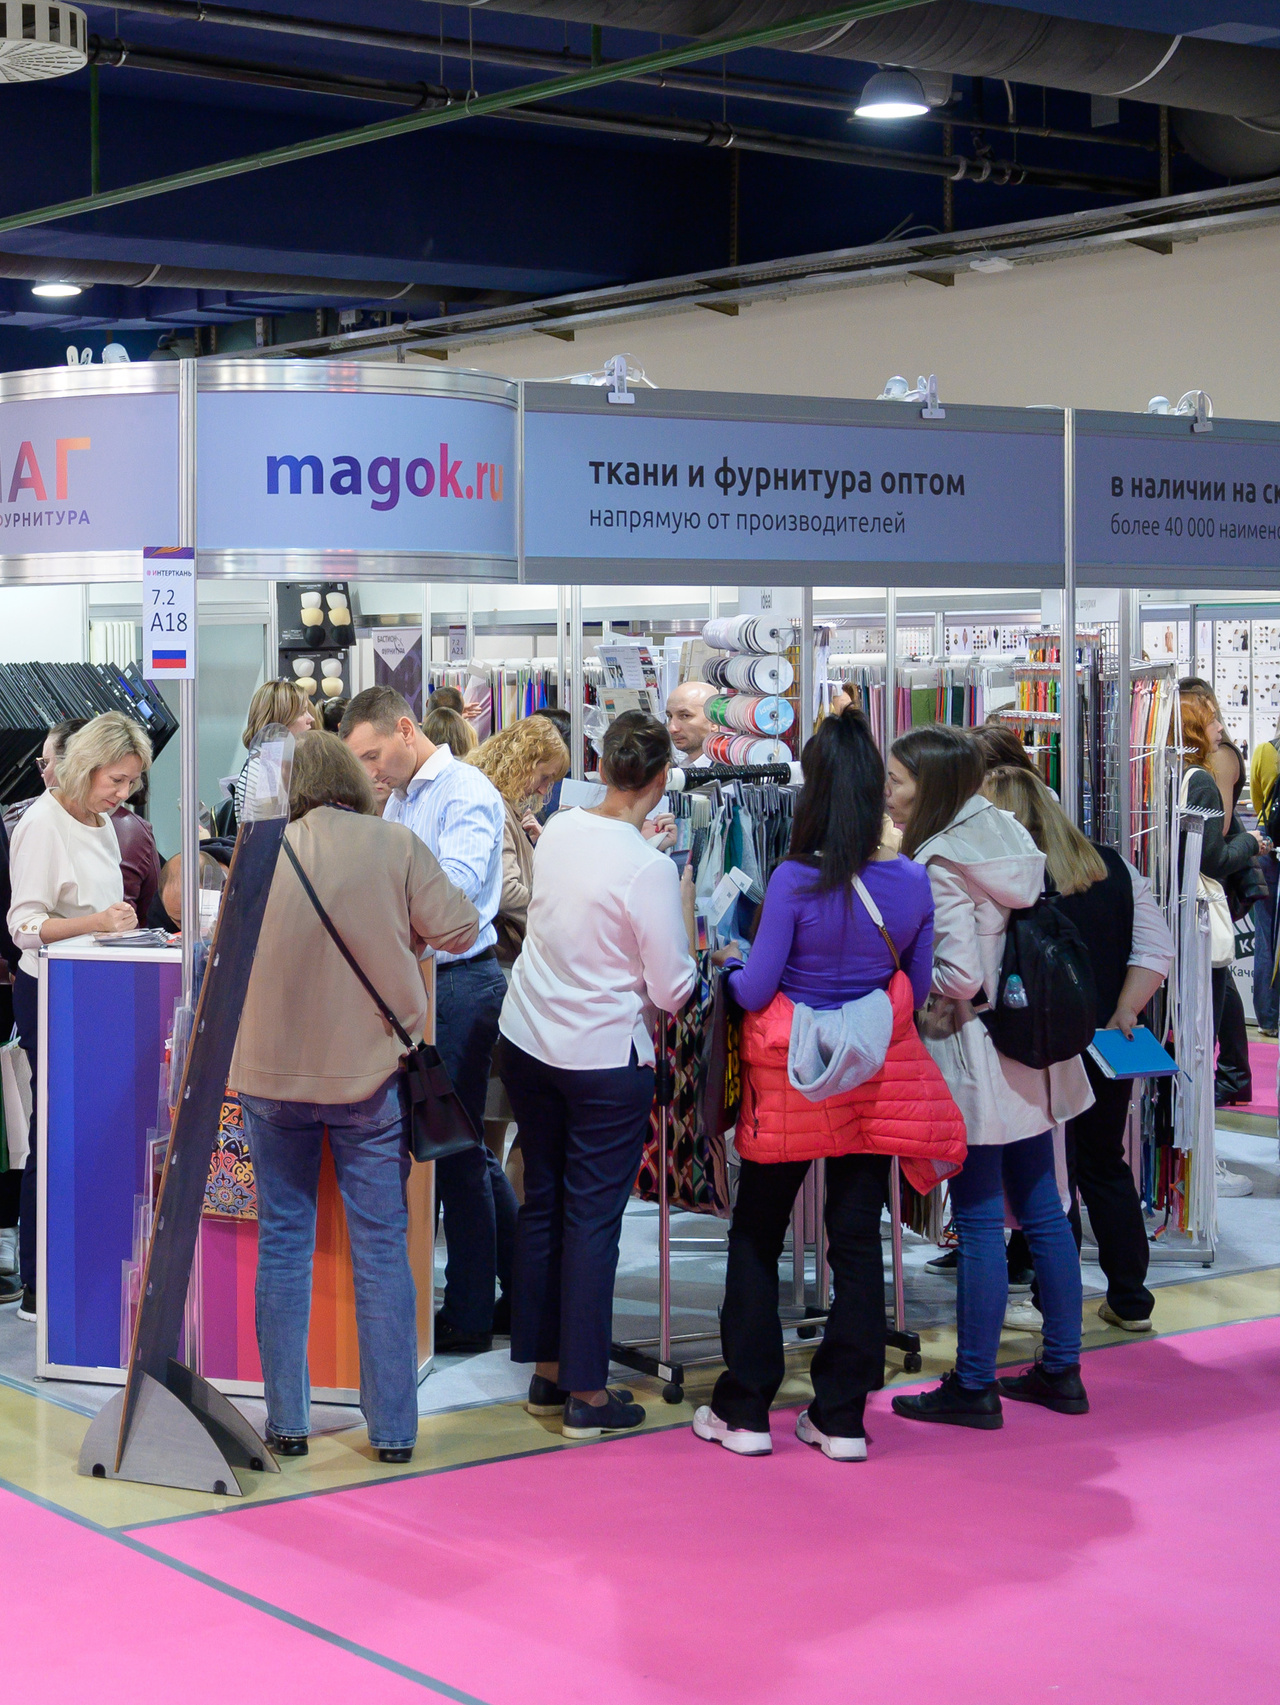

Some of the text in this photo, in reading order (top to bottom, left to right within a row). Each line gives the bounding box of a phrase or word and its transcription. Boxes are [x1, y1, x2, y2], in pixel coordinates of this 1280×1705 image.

[266, 442, 504, 512] magok.ru
[588, 456, 965, 499] ткани и фурнитура оптом
[1111, 476, 1124, 497] в
[1131, 477, 1226, 502] наличии
[1232, 482, 1256, 503] на
[589, 509, 906, 536] напрямую от производителей
[1111, 512, 1160, 536] более
[1164, 516, 1184, 537] 40
[1187, 517, 1215, 538] 000
[152, 569, 193, 577] ИНТЕРТКАНЬ
[151, 589, 175, 606] 7.2
[150, 612, 188, 632] A18
